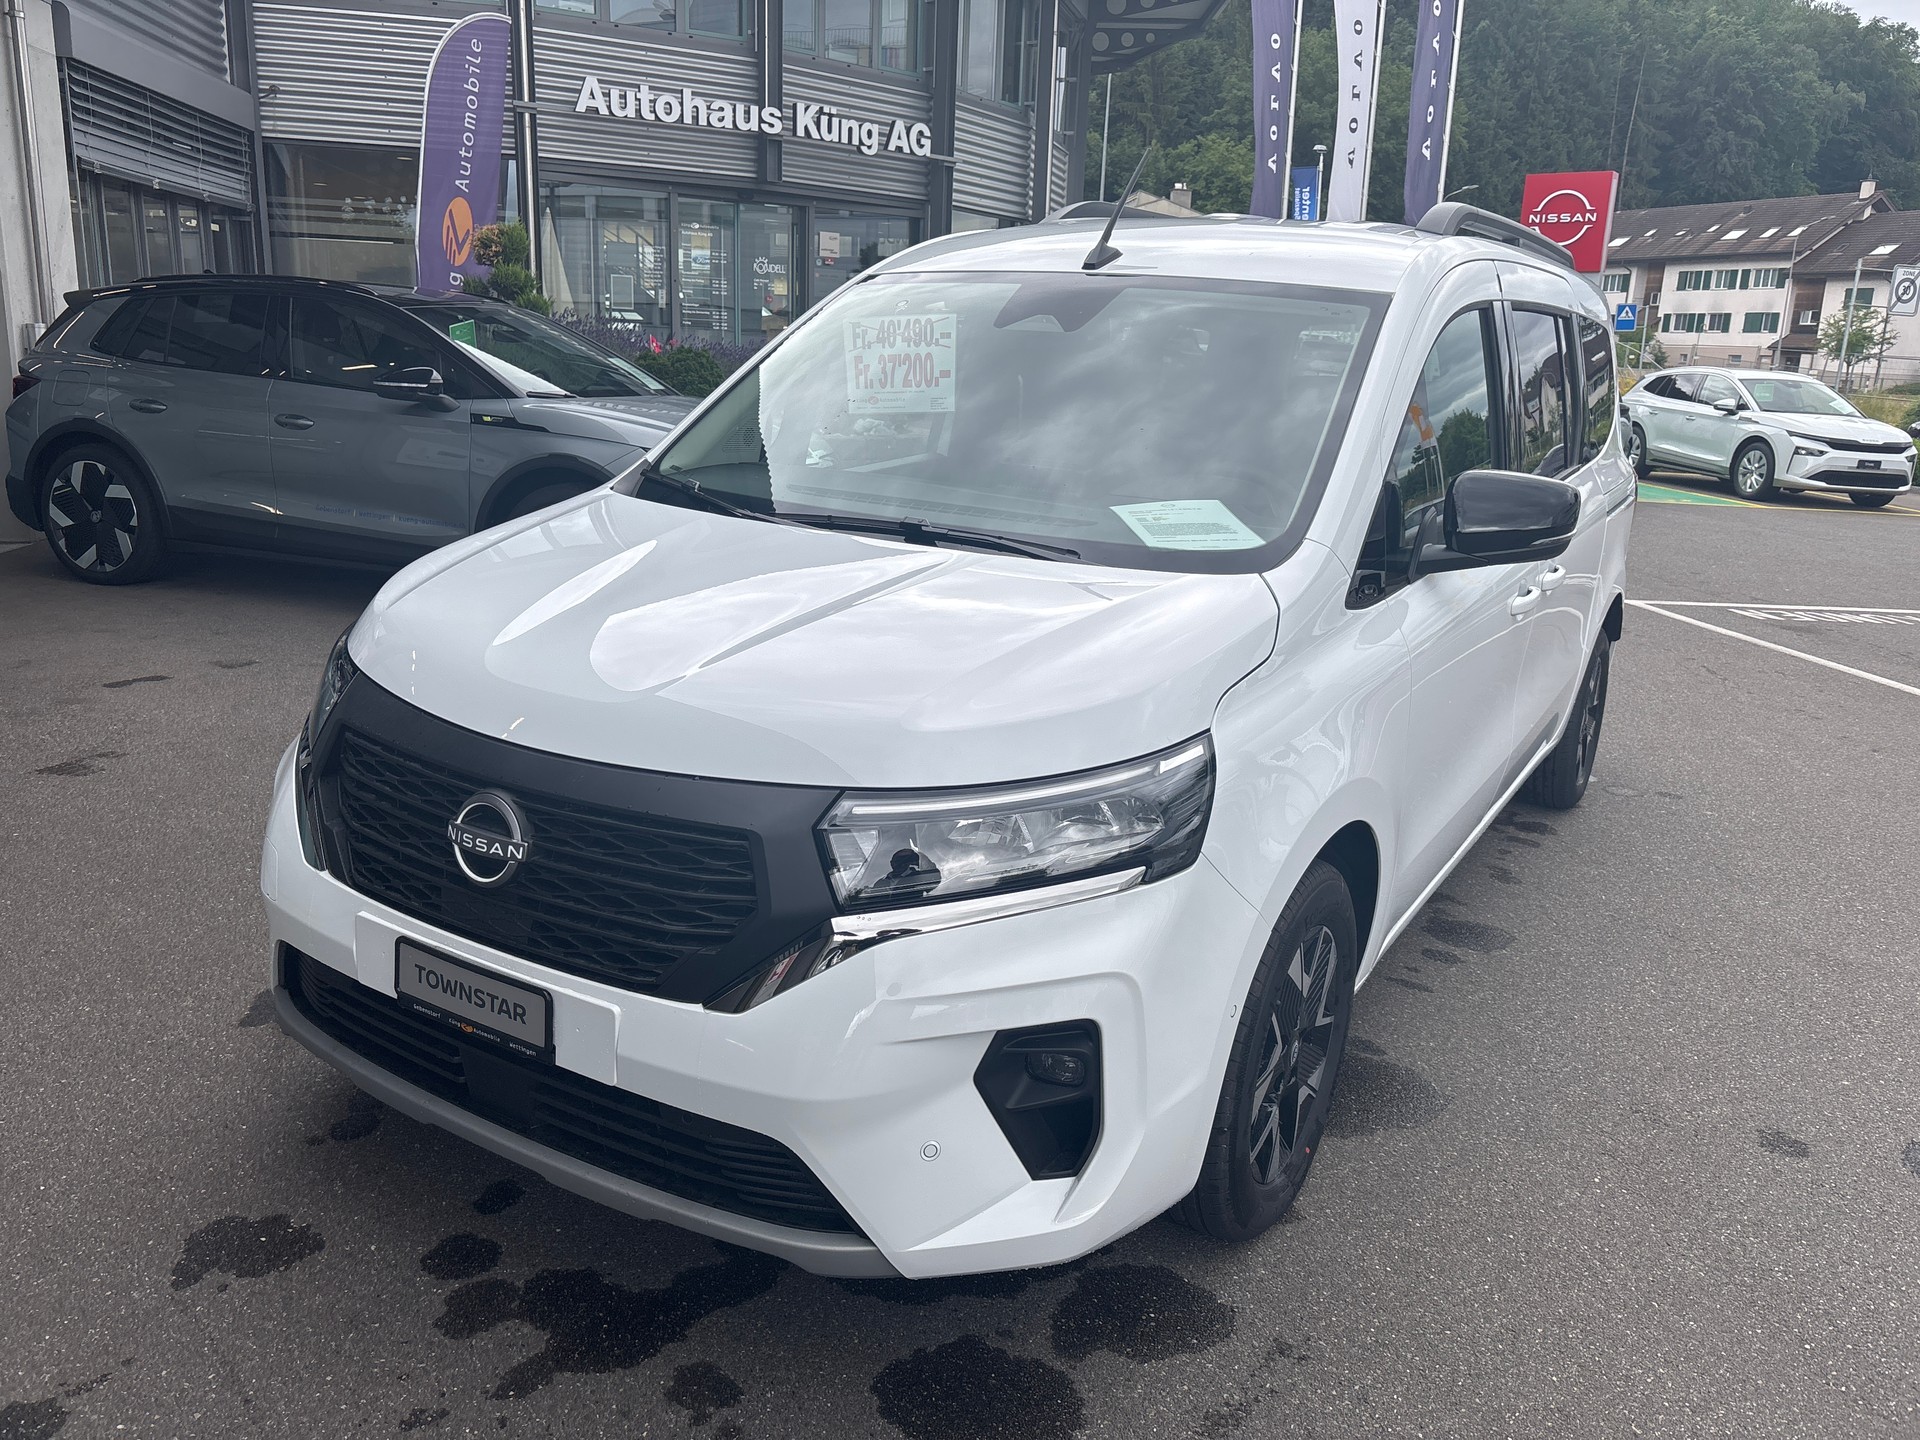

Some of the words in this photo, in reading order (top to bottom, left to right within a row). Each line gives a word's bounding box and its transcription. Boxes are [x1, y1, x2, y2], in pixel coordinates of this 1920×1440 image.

[454, 38, 483, 193] Automobile
[575, 76, 783, 135] Autohaus
[793, 101, 880, 155] Küng
[886, 119, 932, 156] AG
[1528, 211, 1598, 224] NISSAN
[1901, 285, 1911, 296] 30
[852, 321, 872, 349] Fr.
[854, 355, 874, 389] Fr.
[447, 824, 524, 860] NISSAN
[414, 963, 527, 1025] TOWNSTAR
[509, 1041, 537, 1057] Wettingen
